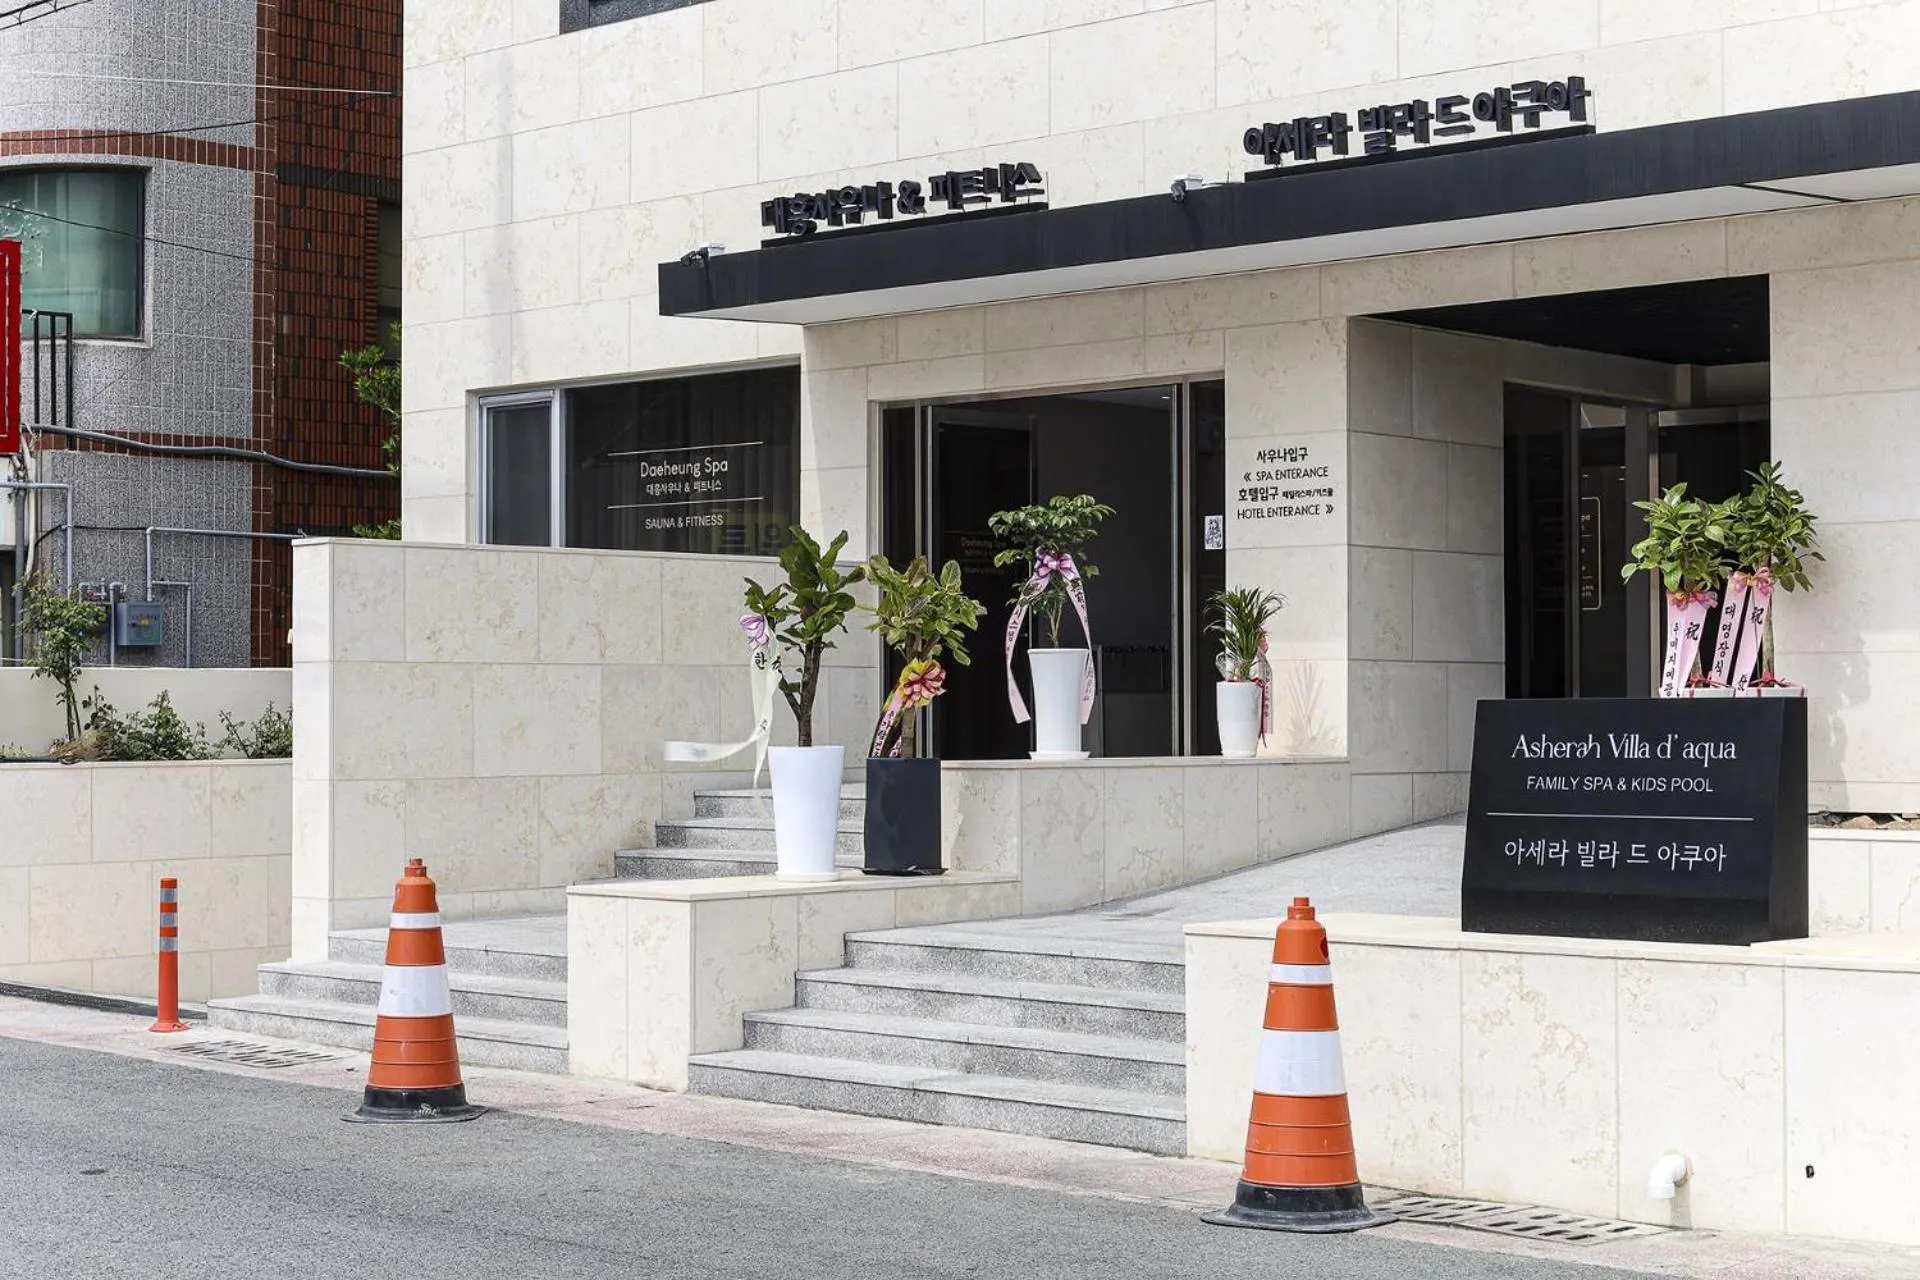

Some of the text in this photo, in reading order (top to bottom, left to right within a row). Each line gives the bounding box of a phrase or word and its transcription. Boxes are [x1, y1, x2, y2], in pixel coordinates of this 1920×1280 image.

[1244, 112, 1353, 165] 아세라
[897, 180, 926, 215] &
[1256, 447, 1309, 464] 사우나입구
[641, 457, 728, 477] Daeheung Spa
[1256, 466, 1329, 482] SPA ENTERANCE
[684, 481, 690, 493] &
[1238, 486, 1279, 502] 호텔입구
[1237, 504, 1320, 520] HOTEL ENTERANCE
[645, 514, 724, 530] SAUNA & FITNESS
[1511, 733, 1601, 759] Asherah
[1607, 733, 1651, 760] Villa
[1526, 775, 1715, 793] FAMILY SPA & KIDS POOL
[1504, 838, 1728, 873] 아세라 빌라 드 아쿠아
